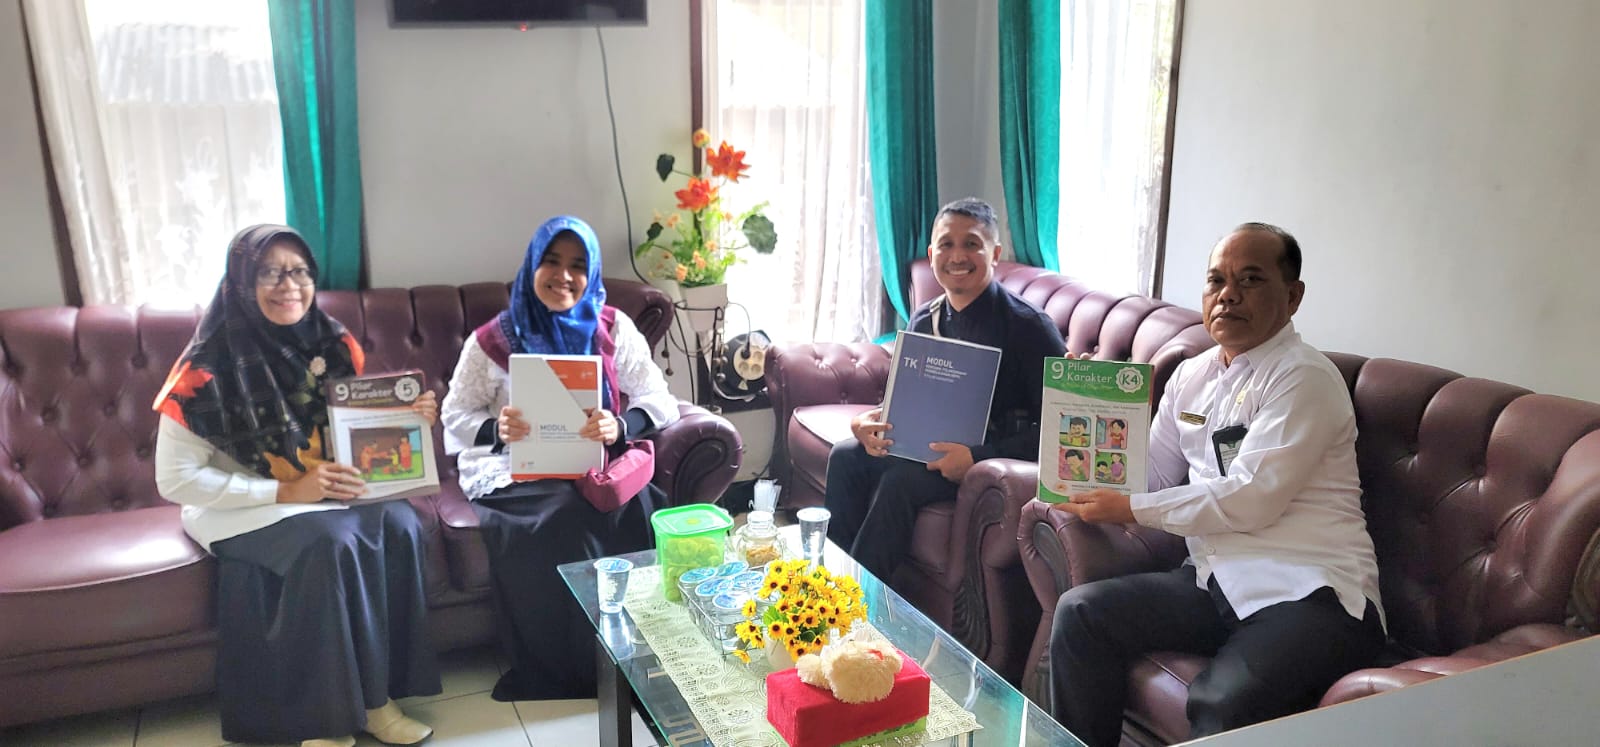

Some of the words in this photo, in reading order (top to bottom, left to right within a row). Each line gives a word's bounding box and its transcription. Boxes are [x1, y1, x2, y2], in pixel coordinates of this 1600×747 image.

[904, 357, 918, 369] TK
[926, 356, 953, 369] MODUL
[1051, 361, 1064, 380] 9
[1067, 361, 1091, 372] Pilar
[1067, 372, 1112, 384] Karakter
[1121, 373, 1138, 386] K4
[335, 383, 349, 401] 9
[403, 383, 414, 397] 5
[540, 424, 568, 432] MODUL
